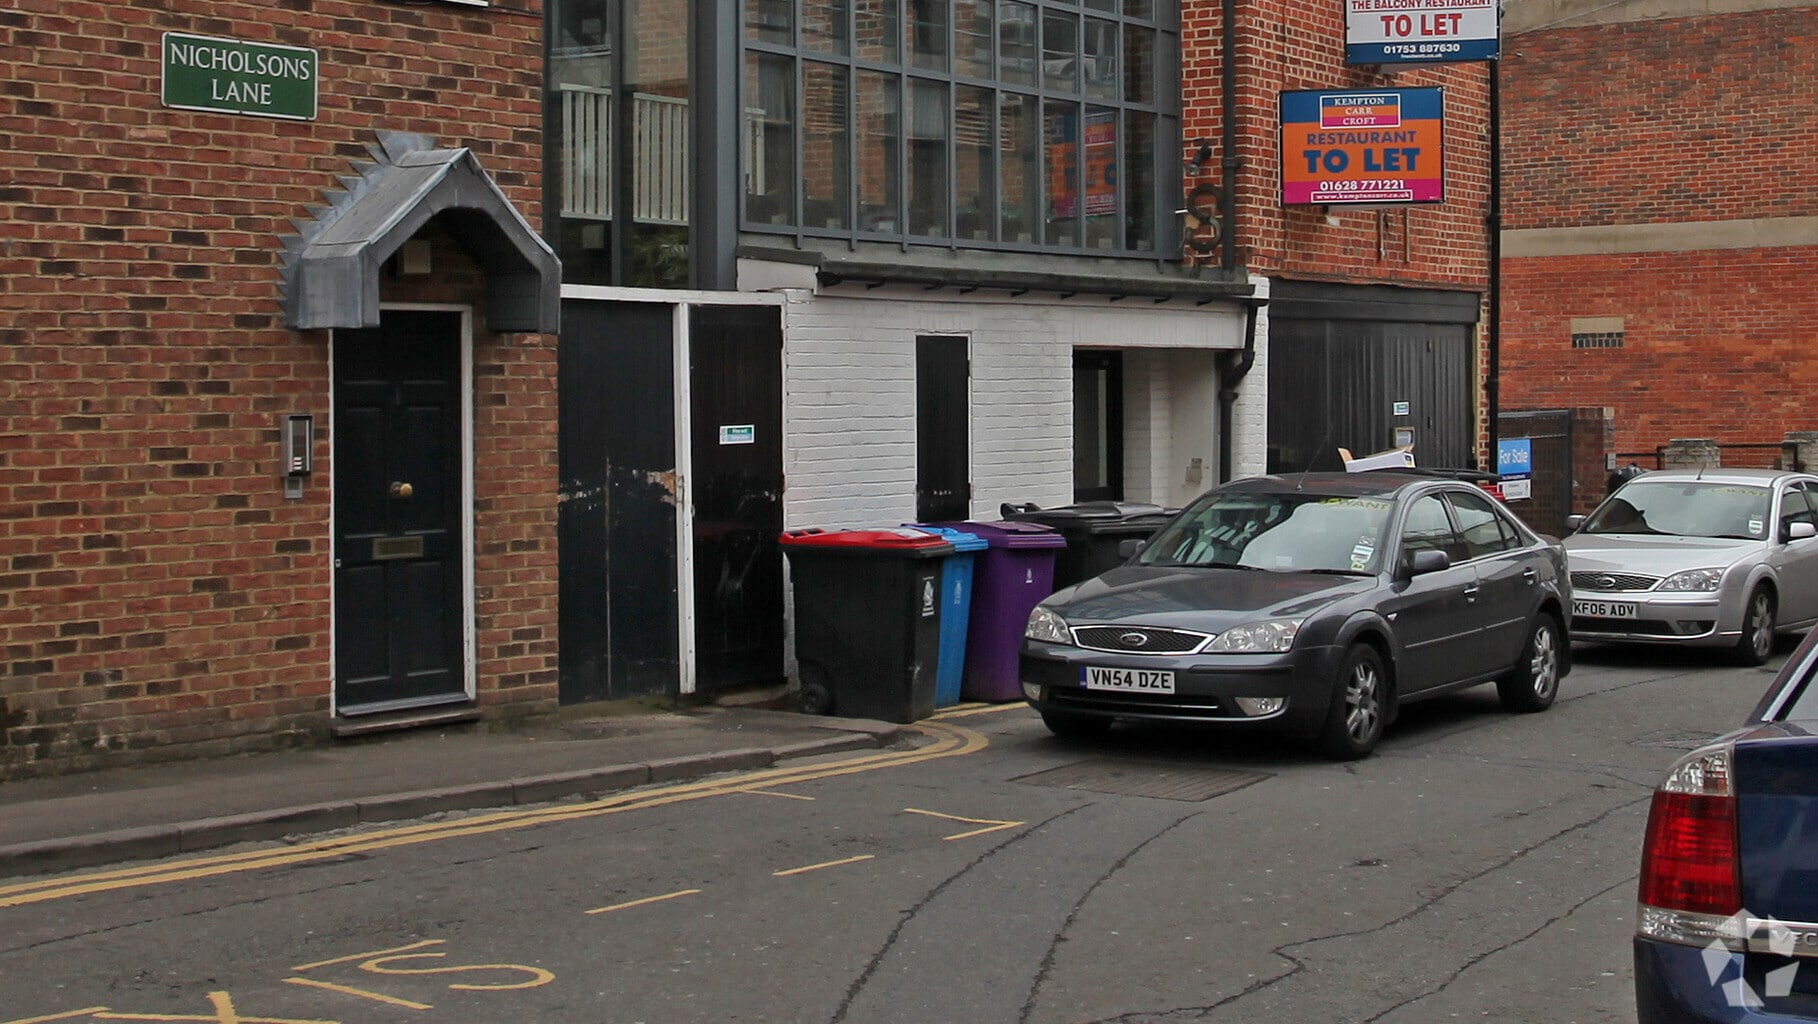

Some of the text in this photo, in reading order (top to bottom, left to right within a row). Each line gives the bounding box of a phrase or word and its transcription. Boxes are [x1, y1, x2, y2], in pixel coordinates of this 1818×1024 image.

[1352, 0, 1371, 10] THE
[1381, 13, 1462, 37] TO LET
[1383, 45, 1416, 54] 01753
[170, 42, 310, 80] NICHOLSONS
[211, 78, 272, 105] LANE
[1334, 97, 1385, 106] KEMPTON
[1345, 107, 1373, 115] CARR
[1342, 117, 1376, 125] CROFT
[1307, 131, 1417, 145] RESTAURANT
[1303, 148, 1420, 174] TO LET
[1320, 179, 1404, 191] 01628 771221
[1500, 448, 1528, 465] For Sale
[1574, 602, 1634, 616] KF06 ADV
[1091, 669, 1171, 689] VN54 DZE
